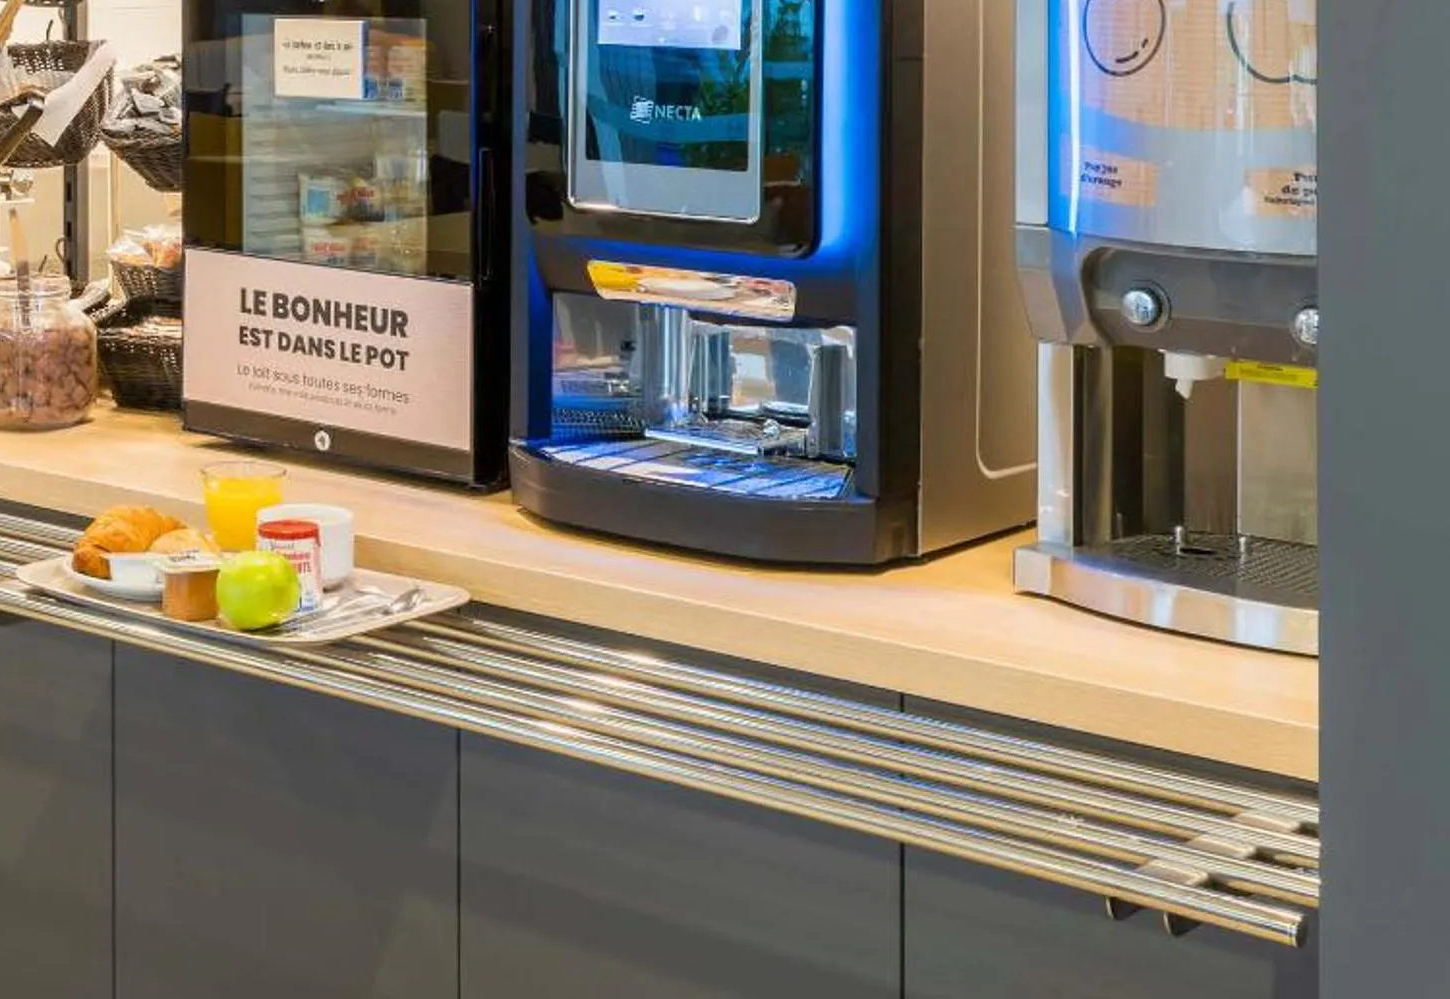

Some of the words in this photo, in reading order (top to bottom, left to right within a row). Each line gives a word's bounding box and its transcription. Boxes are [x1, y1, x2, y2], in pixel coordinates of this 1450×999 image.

[655, 104, 702, 121] NECTA
[240, 286, 268, 317] LE
[272, 292, 409, 339] BONHEUR
[239, 325, 274, 349] EST
[278, 331, 335, 361] DANS
[339, 341, 362, 364] LE
[365, 345, 410, 371] POT
[237, 364, 250, 377] Le
[253, 366, 270, 381] lait
[303, 374, 340, 392] toutes
[343, 382, 363, 398] ses
[365, 383, 411, 405] formes
